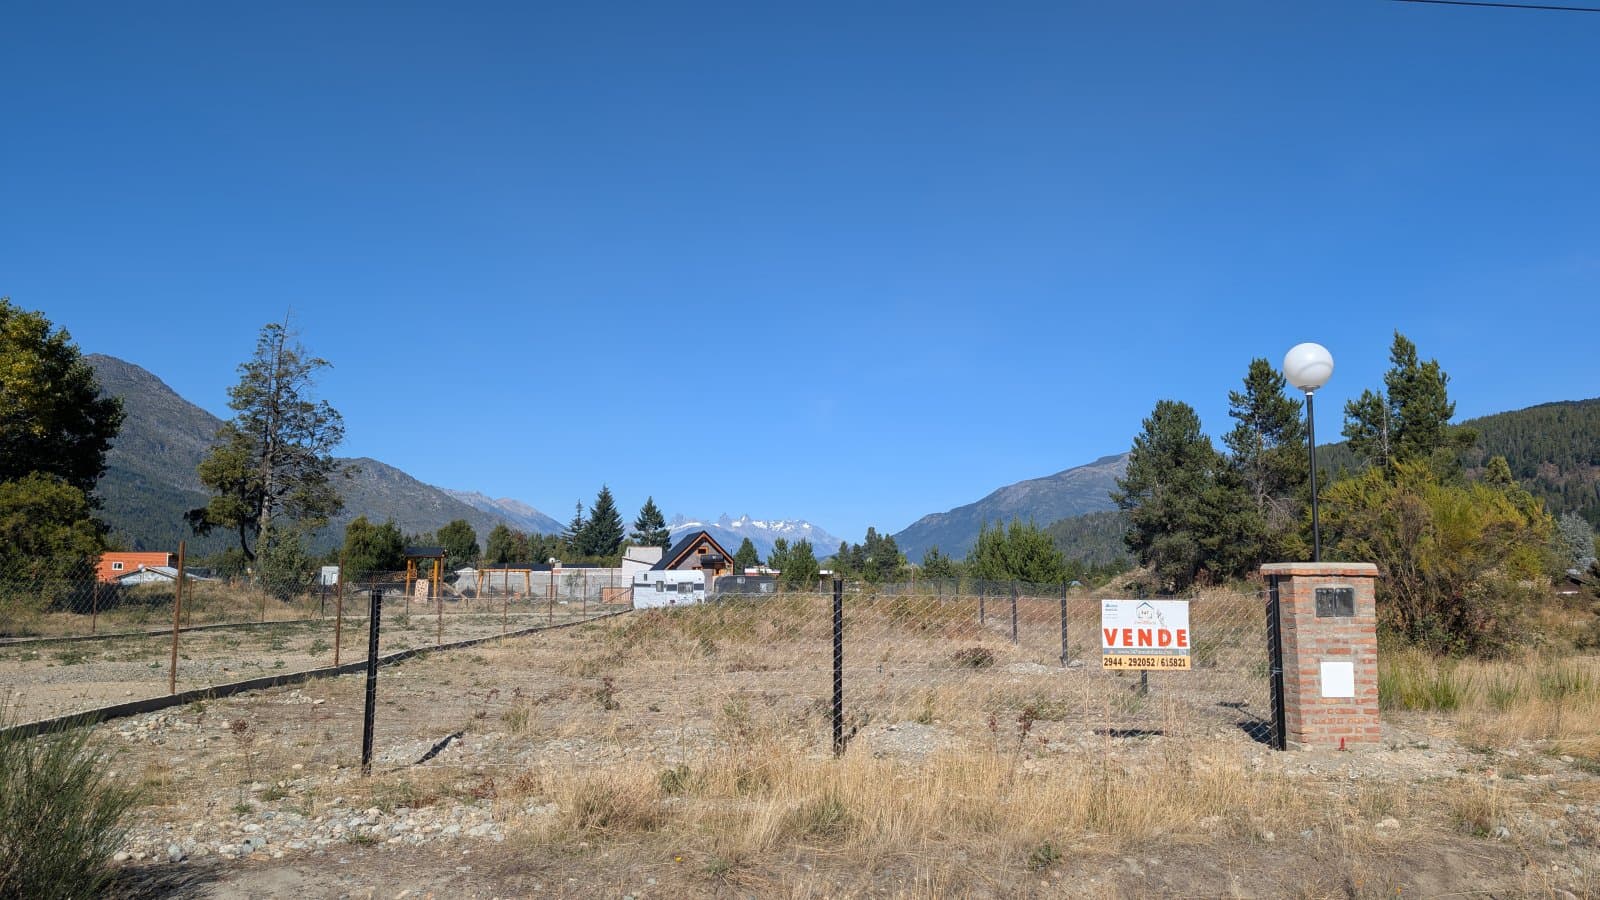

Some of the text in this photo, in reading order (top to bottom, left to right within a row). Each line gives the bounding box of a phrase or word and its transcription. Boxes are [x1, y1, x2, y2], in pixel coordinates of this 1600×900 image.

[1103, 628, 1188, 647] VENDE
[1103, 657, 1123, 667] 2944
[1128, 657, 1155, 667] 292052
[1160, 658, 1186, 667] 615821
